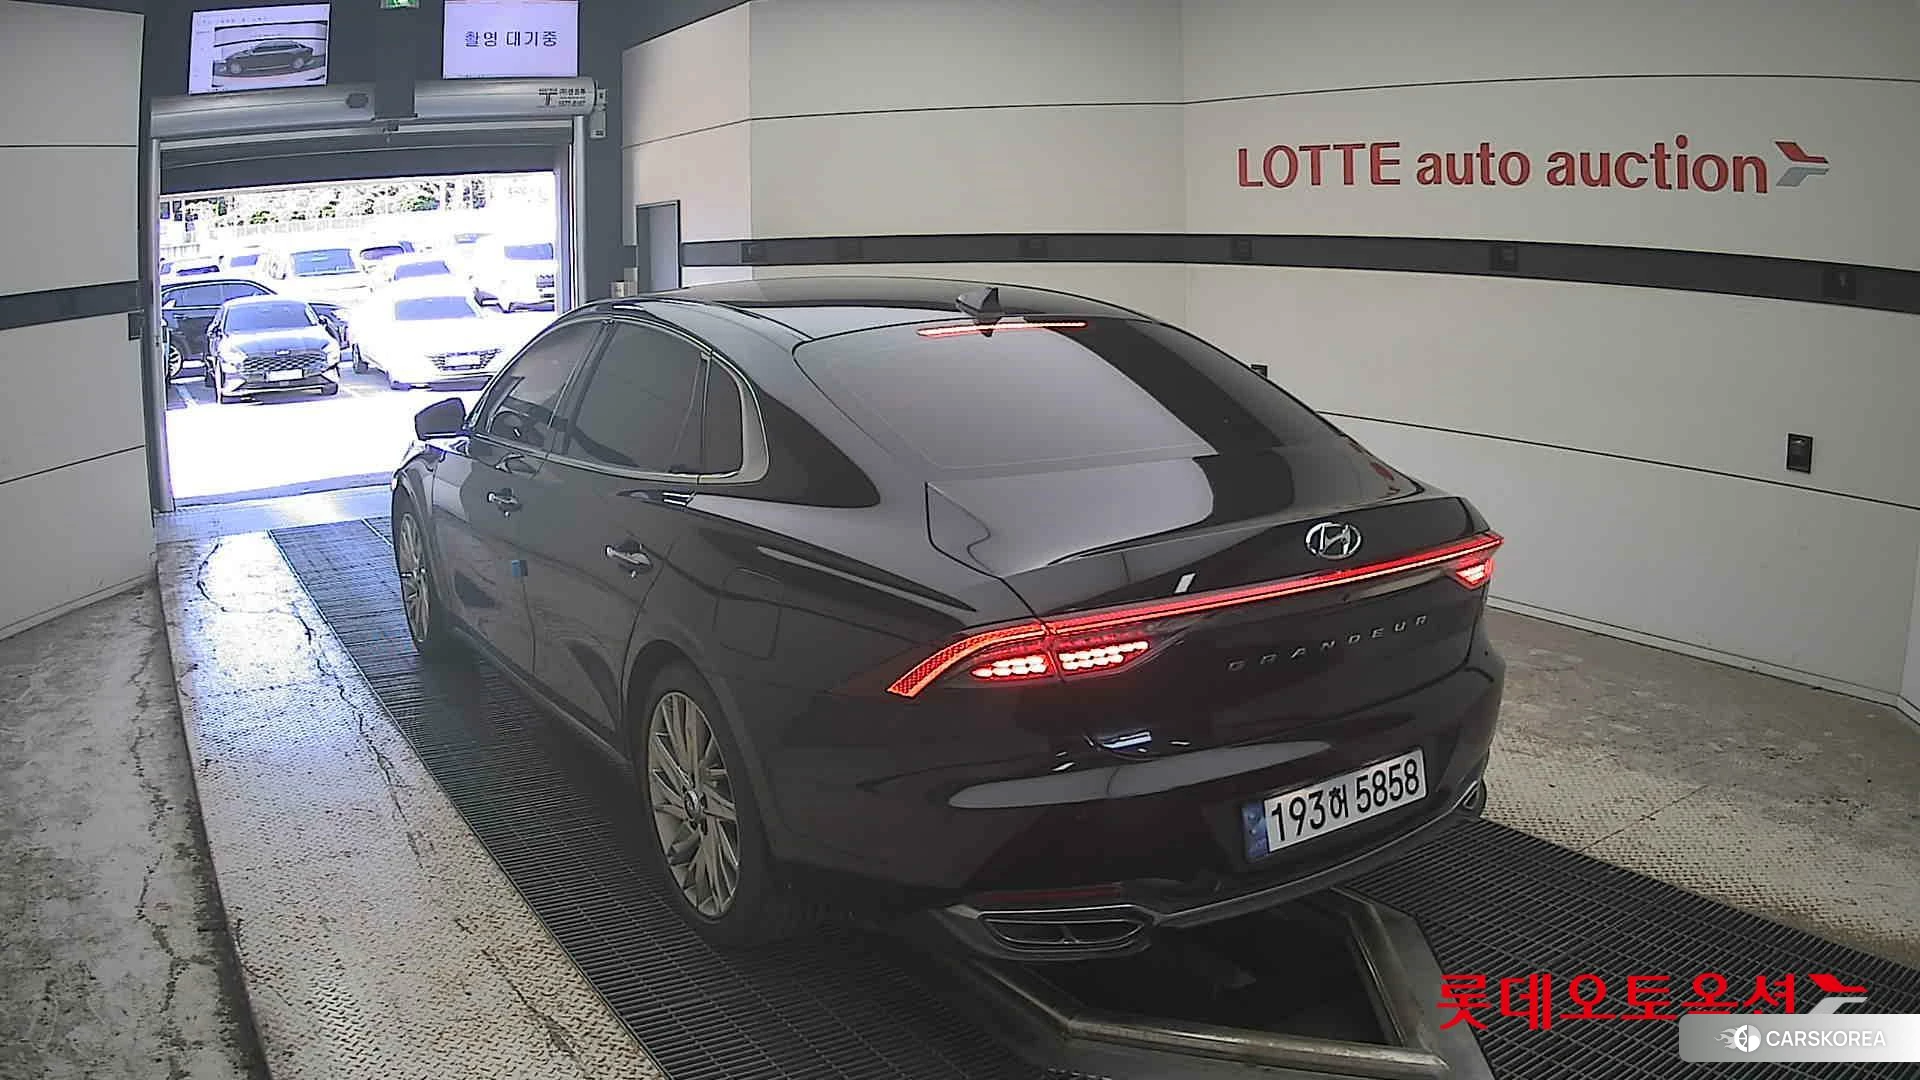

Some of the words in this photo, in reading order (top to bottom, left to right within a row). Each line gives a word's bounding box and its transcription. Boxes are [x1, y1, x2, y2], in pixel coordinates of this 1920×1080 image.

[506, 31, 557, 47] 대기중
[1238, 141, 1400, 188] LOTTE
[1415, 142, 1531, 187] auto
[1546, 134, 1769, 194] auction
[1227, 614, 1428, 672] GRANDEUR
